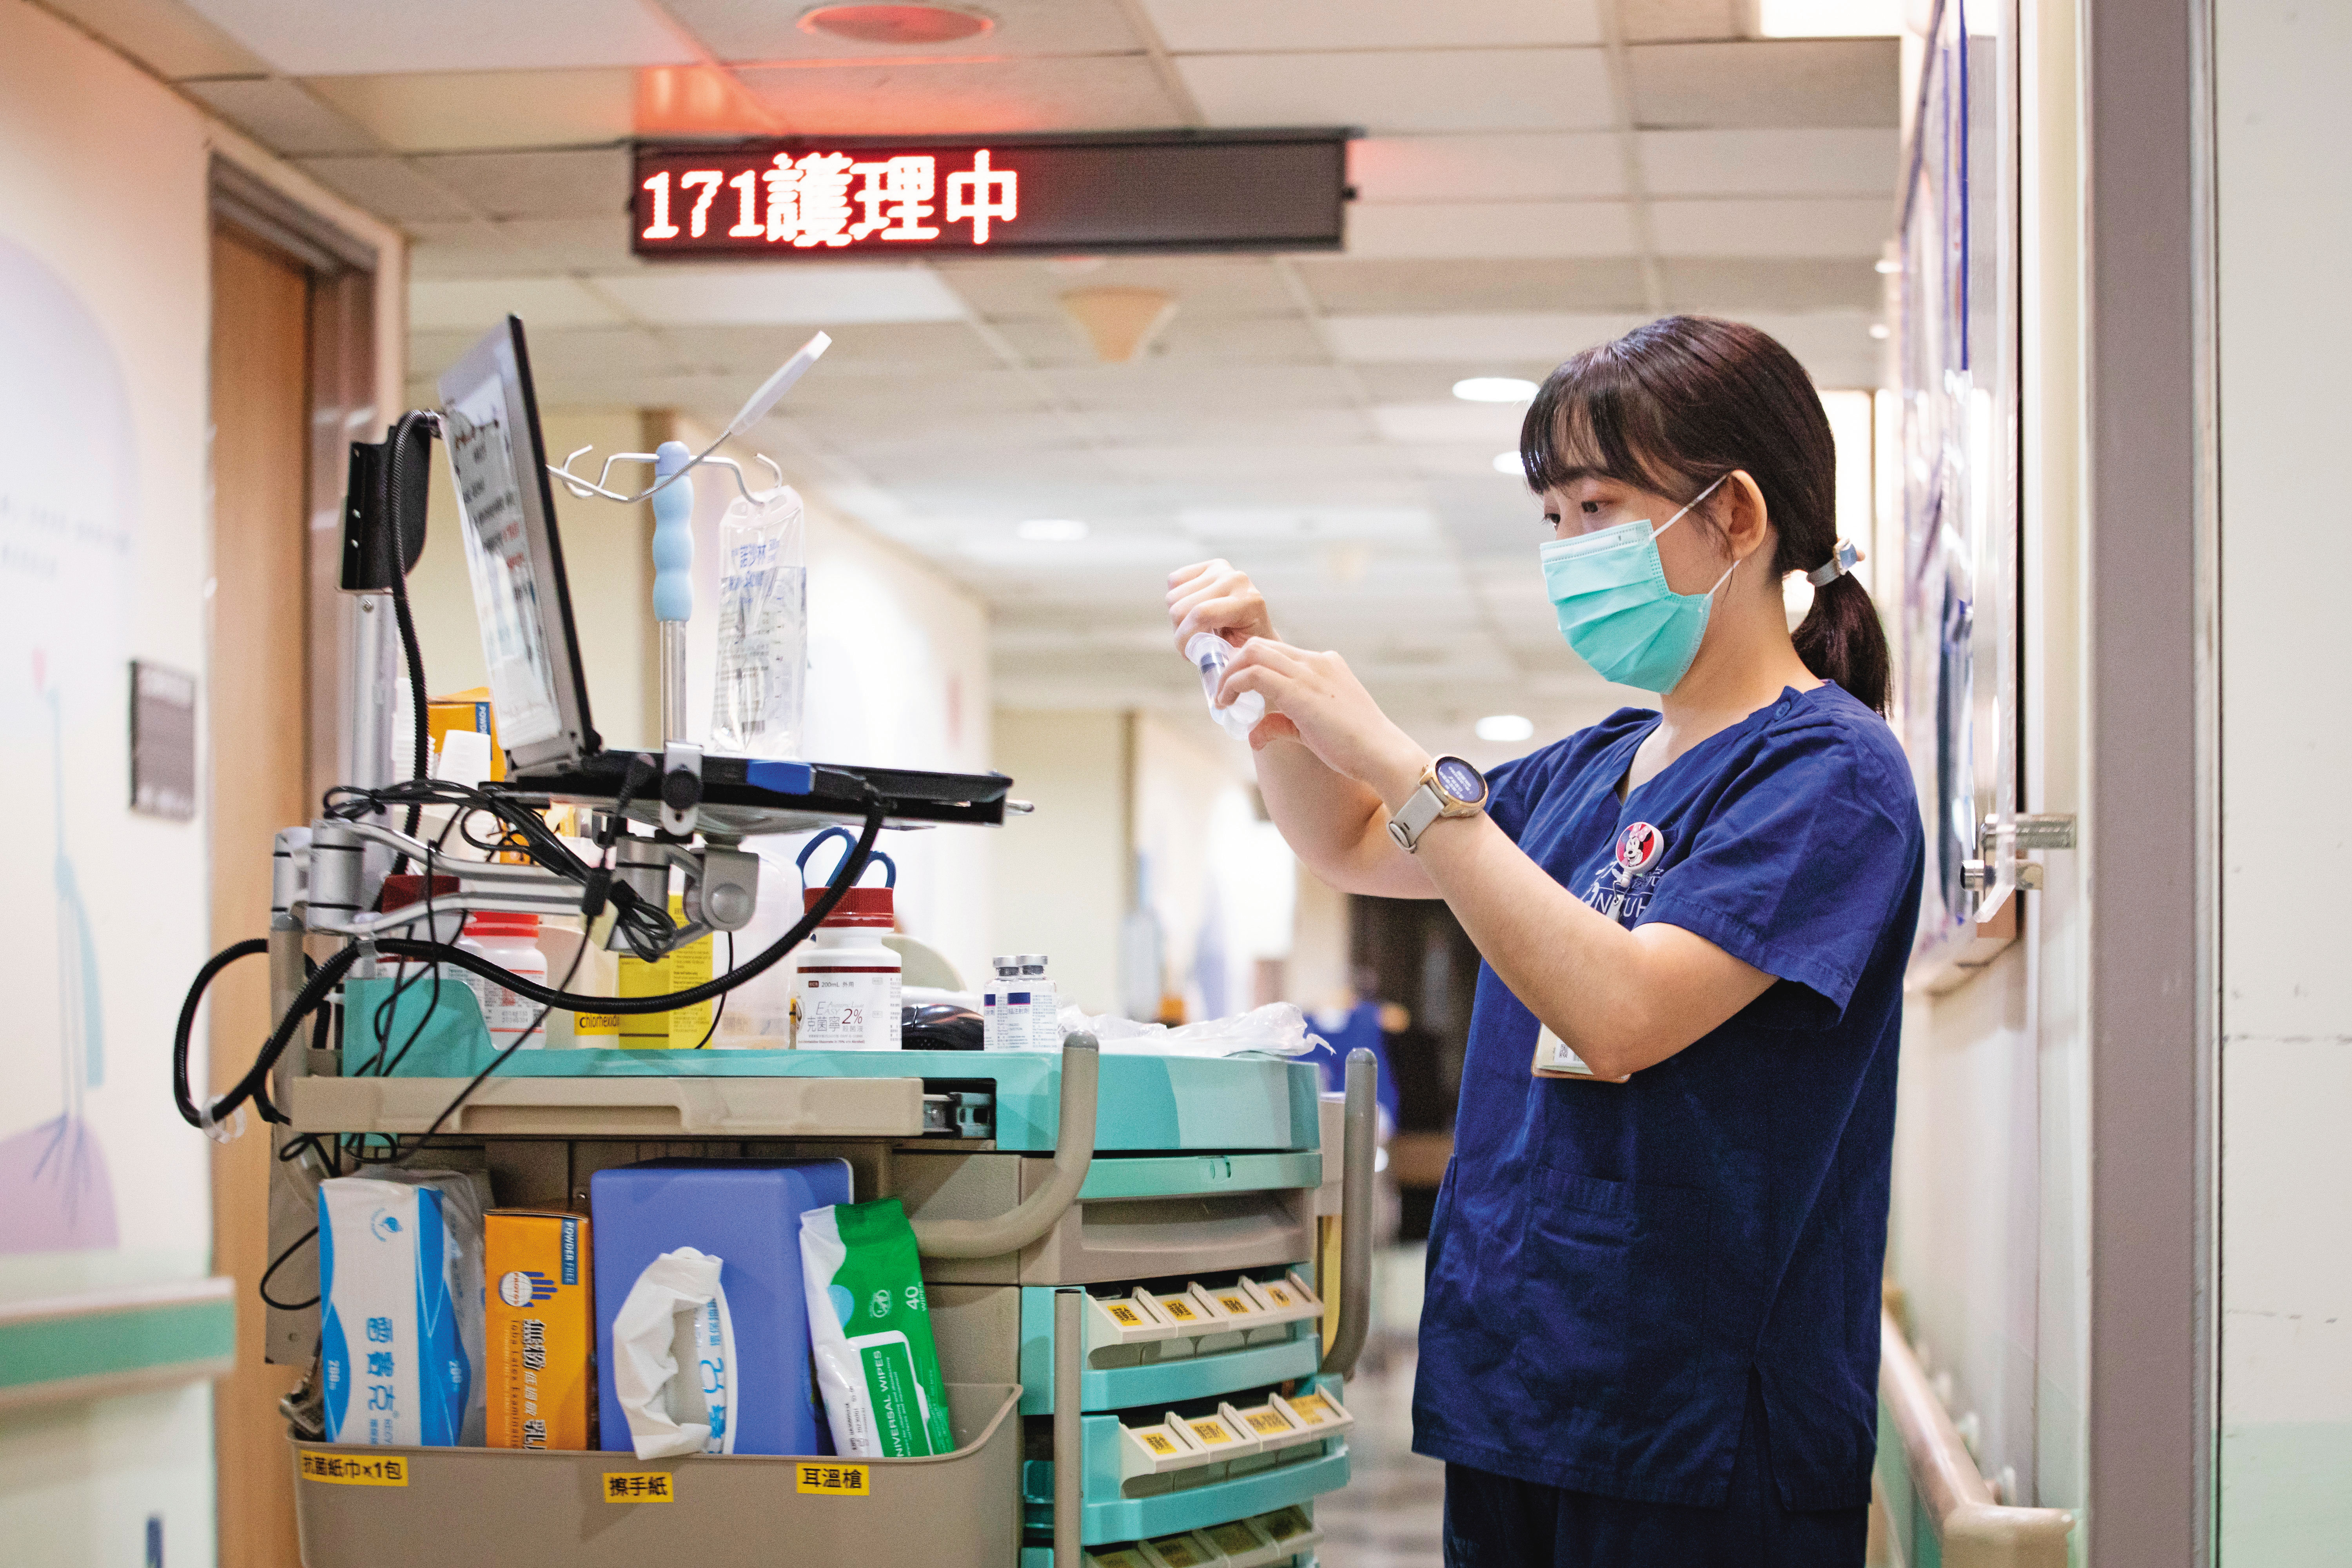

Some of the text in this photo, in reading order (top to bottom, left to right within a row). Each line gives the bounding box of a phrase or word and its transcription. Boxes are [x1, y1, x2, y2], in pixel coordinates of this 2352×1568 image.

[642, 149, 1018, 247] 171護理中
[808, 1016, 840, 1031] 克菌寧
[842, 1009, 862, 1024] 2%
[564, 1221, 574, 1283] POWDER FREE
[905, 1286, 920, 1310] 40
[873, 1351, 888, 1392] WIPES
[523, 1319, 547, 1449] 無粉低過敏乳
[610, 1477, 668, 1496] 擦手紙
[802, 1468, 862, 1488] 耳溫槍
